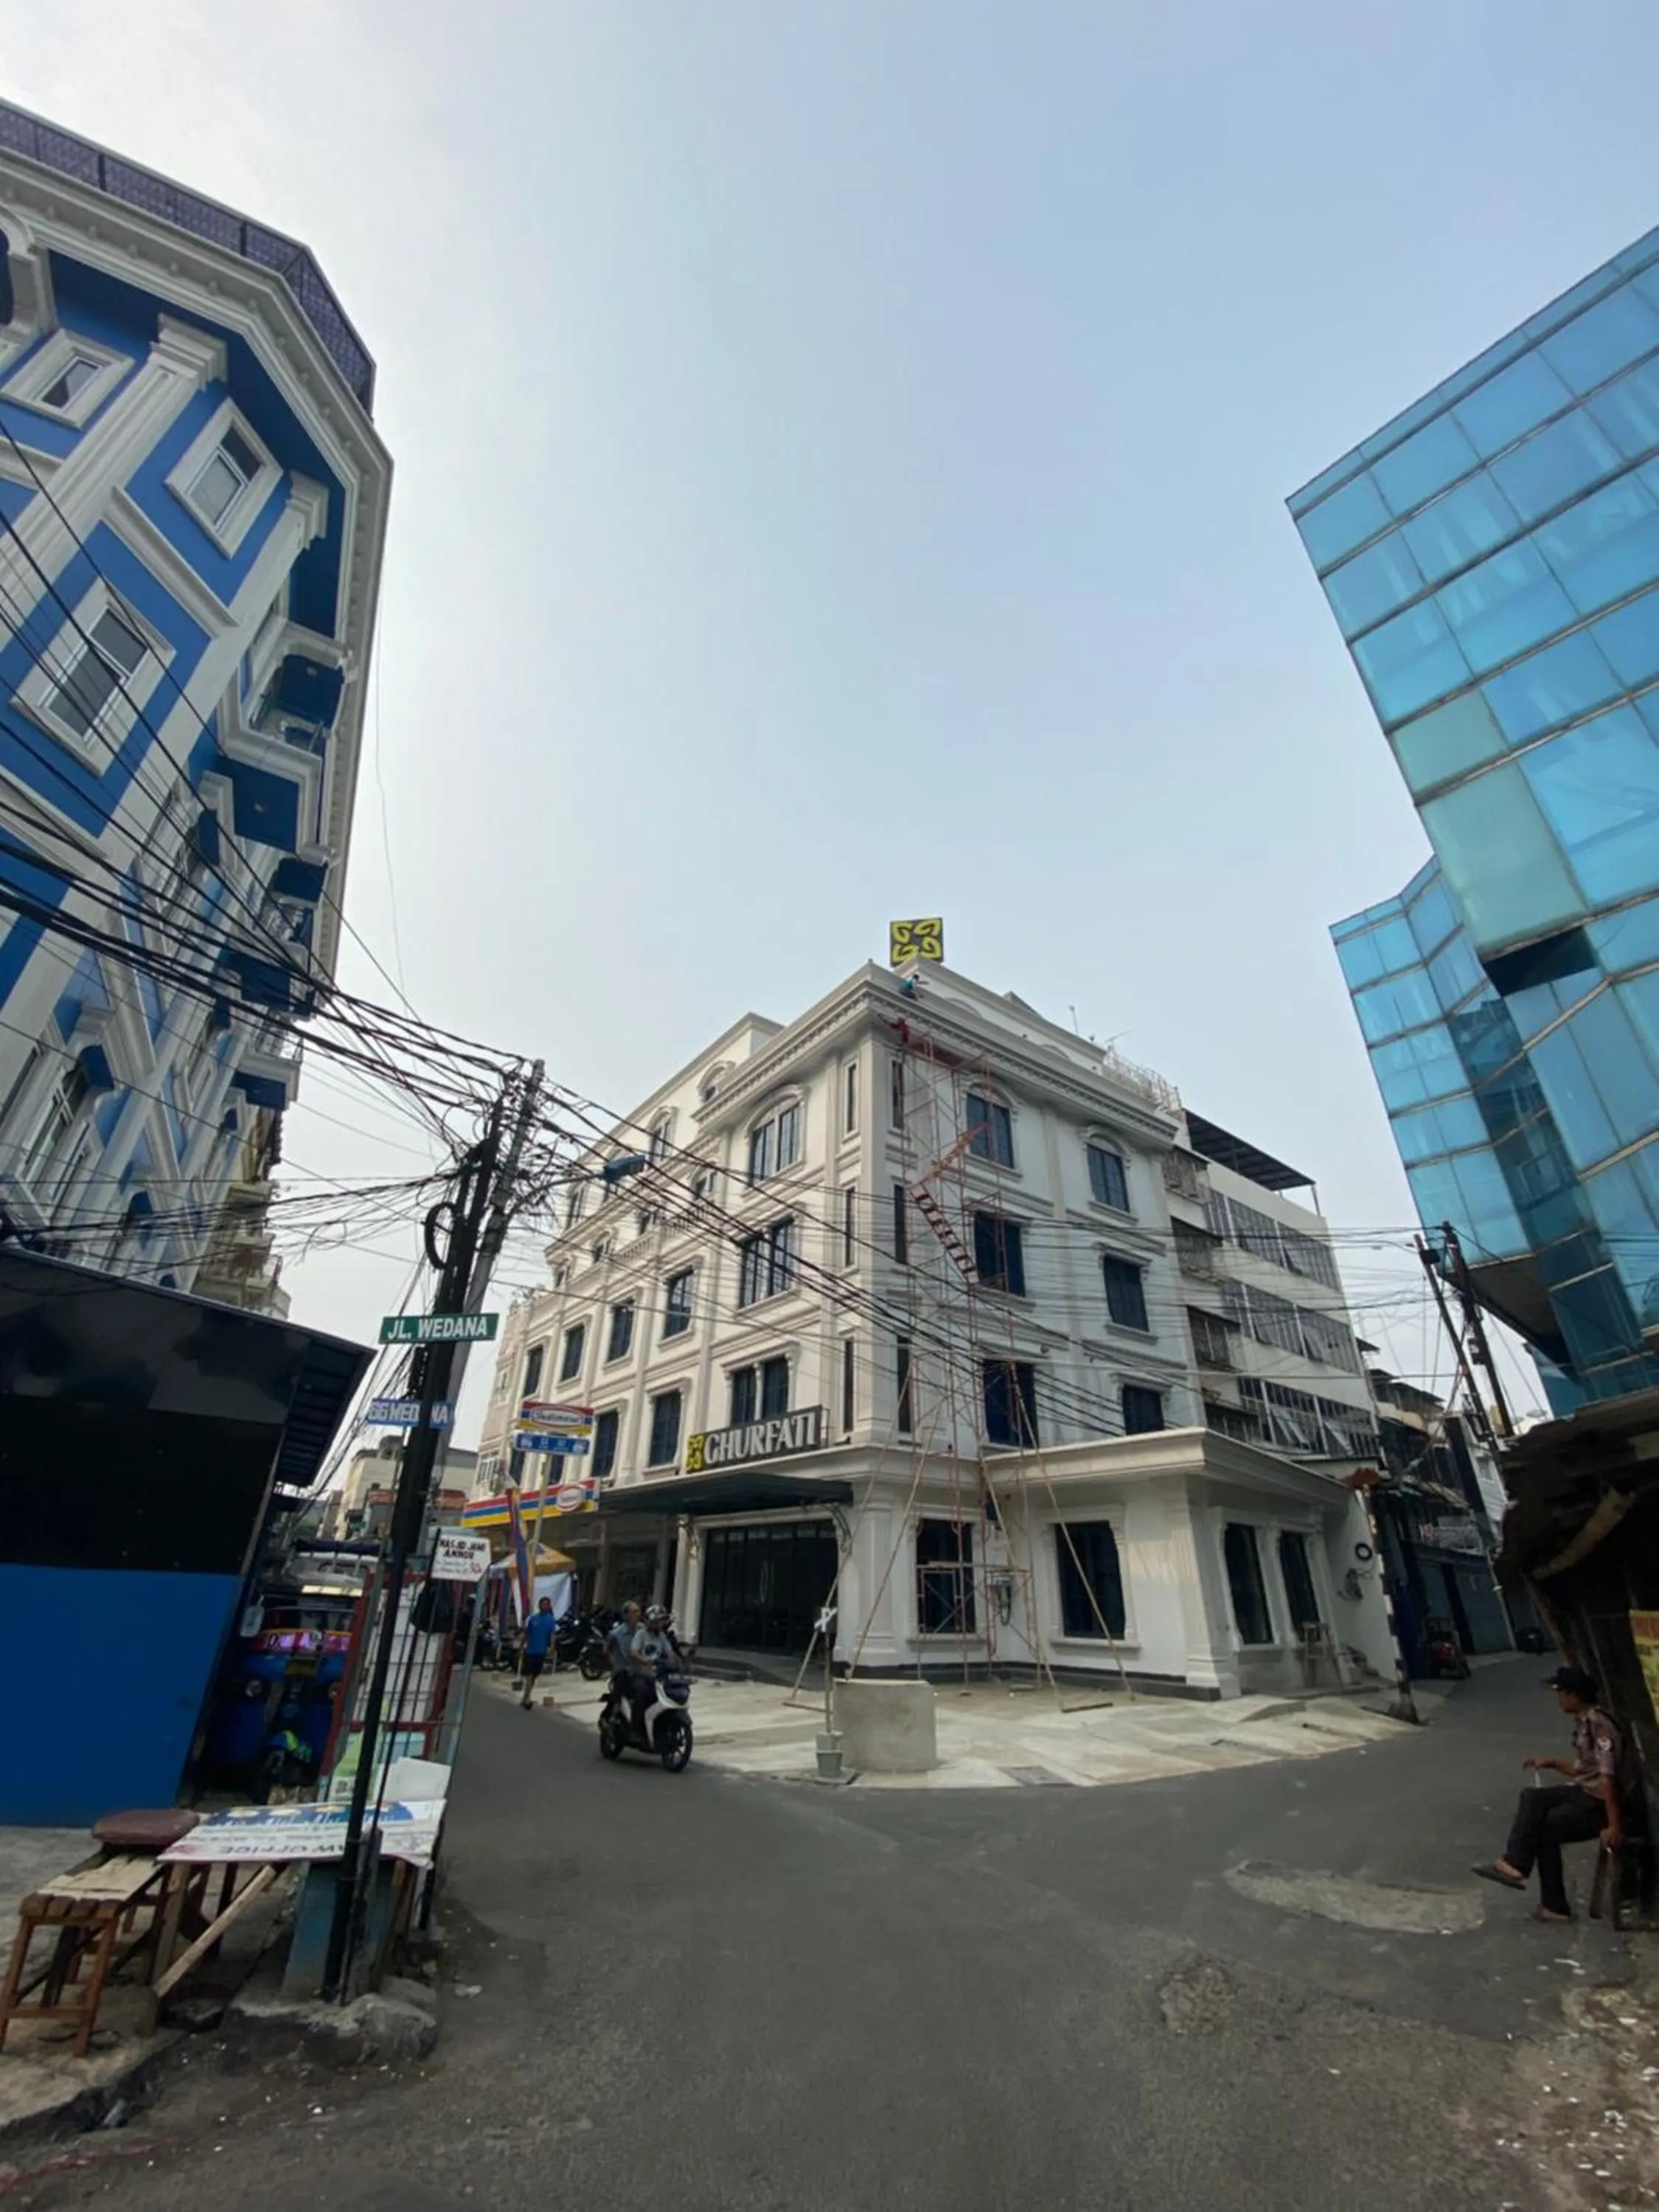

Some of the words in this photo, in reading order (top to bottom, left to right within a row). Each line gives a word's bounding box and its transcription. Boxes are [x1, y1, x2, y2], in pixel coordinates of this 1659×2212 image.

[387, 1318, 412, 1340] JL.
[416, 1315, 488, 1339] WEDANA
[389, 1403, 448, 1424] WEDNA
[703, 1411, 817, 1464] GHURFATI
